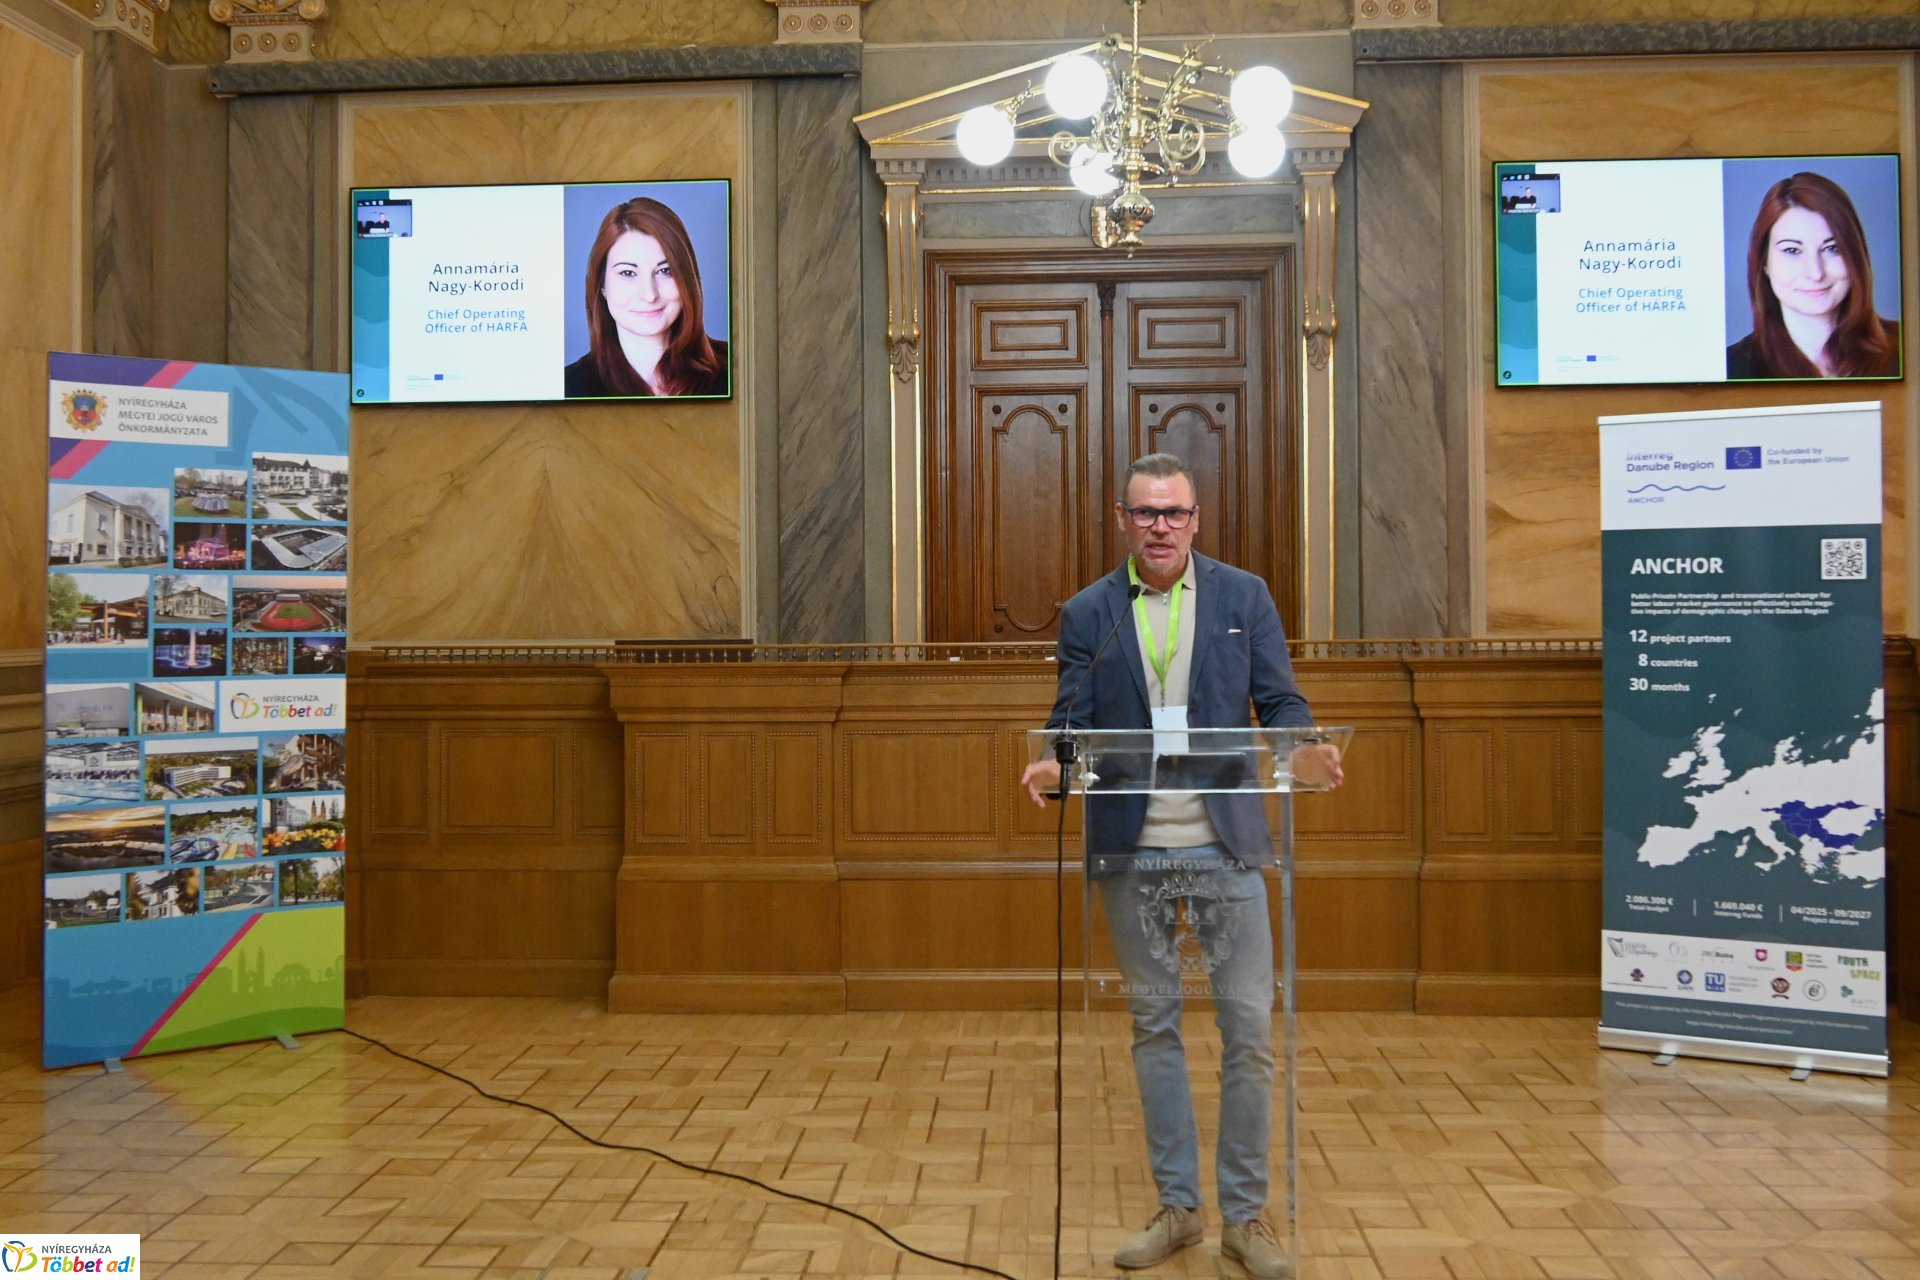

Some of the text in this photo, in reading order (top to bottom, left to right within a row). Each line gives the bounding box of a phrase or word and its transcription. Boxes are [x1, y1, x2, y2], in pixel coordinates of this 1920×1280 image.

[1583, 239, 1676, 252] Annamária
[433, 261, 519, 275] Annamária
[1579, 256, 1681, 274] Nagy-Korodi
[428, 279, 524, 296] Nagy-Korodi
[1578, 287, 1684, 301] Chief Operating
[1576, 301, 1621, 313] Officer
[1625, 301, 1639, 312] of
[427, 308, 526, 321] Chief Operating
[425, 322, 467, 334] Officer
[470, 322, 483, 333] of
[118, 397, 188, 410] NYÍREGYHÁZA
[118, 411, 156, 421] MEGYEI
[186, 413, 218, 425] VÁROS
[118, 421, 208, 437] ÖNKORMÁNYZATA
[1766, 447, 1823, 456] Co-funded by
[1626, 460, 1715, 473] Danube Region
[1767, 458, 1781, 466] the
[1783, 457, 1822, 466] European
[1627, 496, 1665, 504] ANCHOR
[1630, 556, 1724, 576] ANCHOR
[1629, 629, 1732, 645] 12 project partners
[1638, 653, 1699, 667] 8 countries
[1629, 678, 1690, 692] 30 months
[262, 695, 319, 704] NYÍREGYHÁZA
[262, 703, 338, 719] Többet ad!
